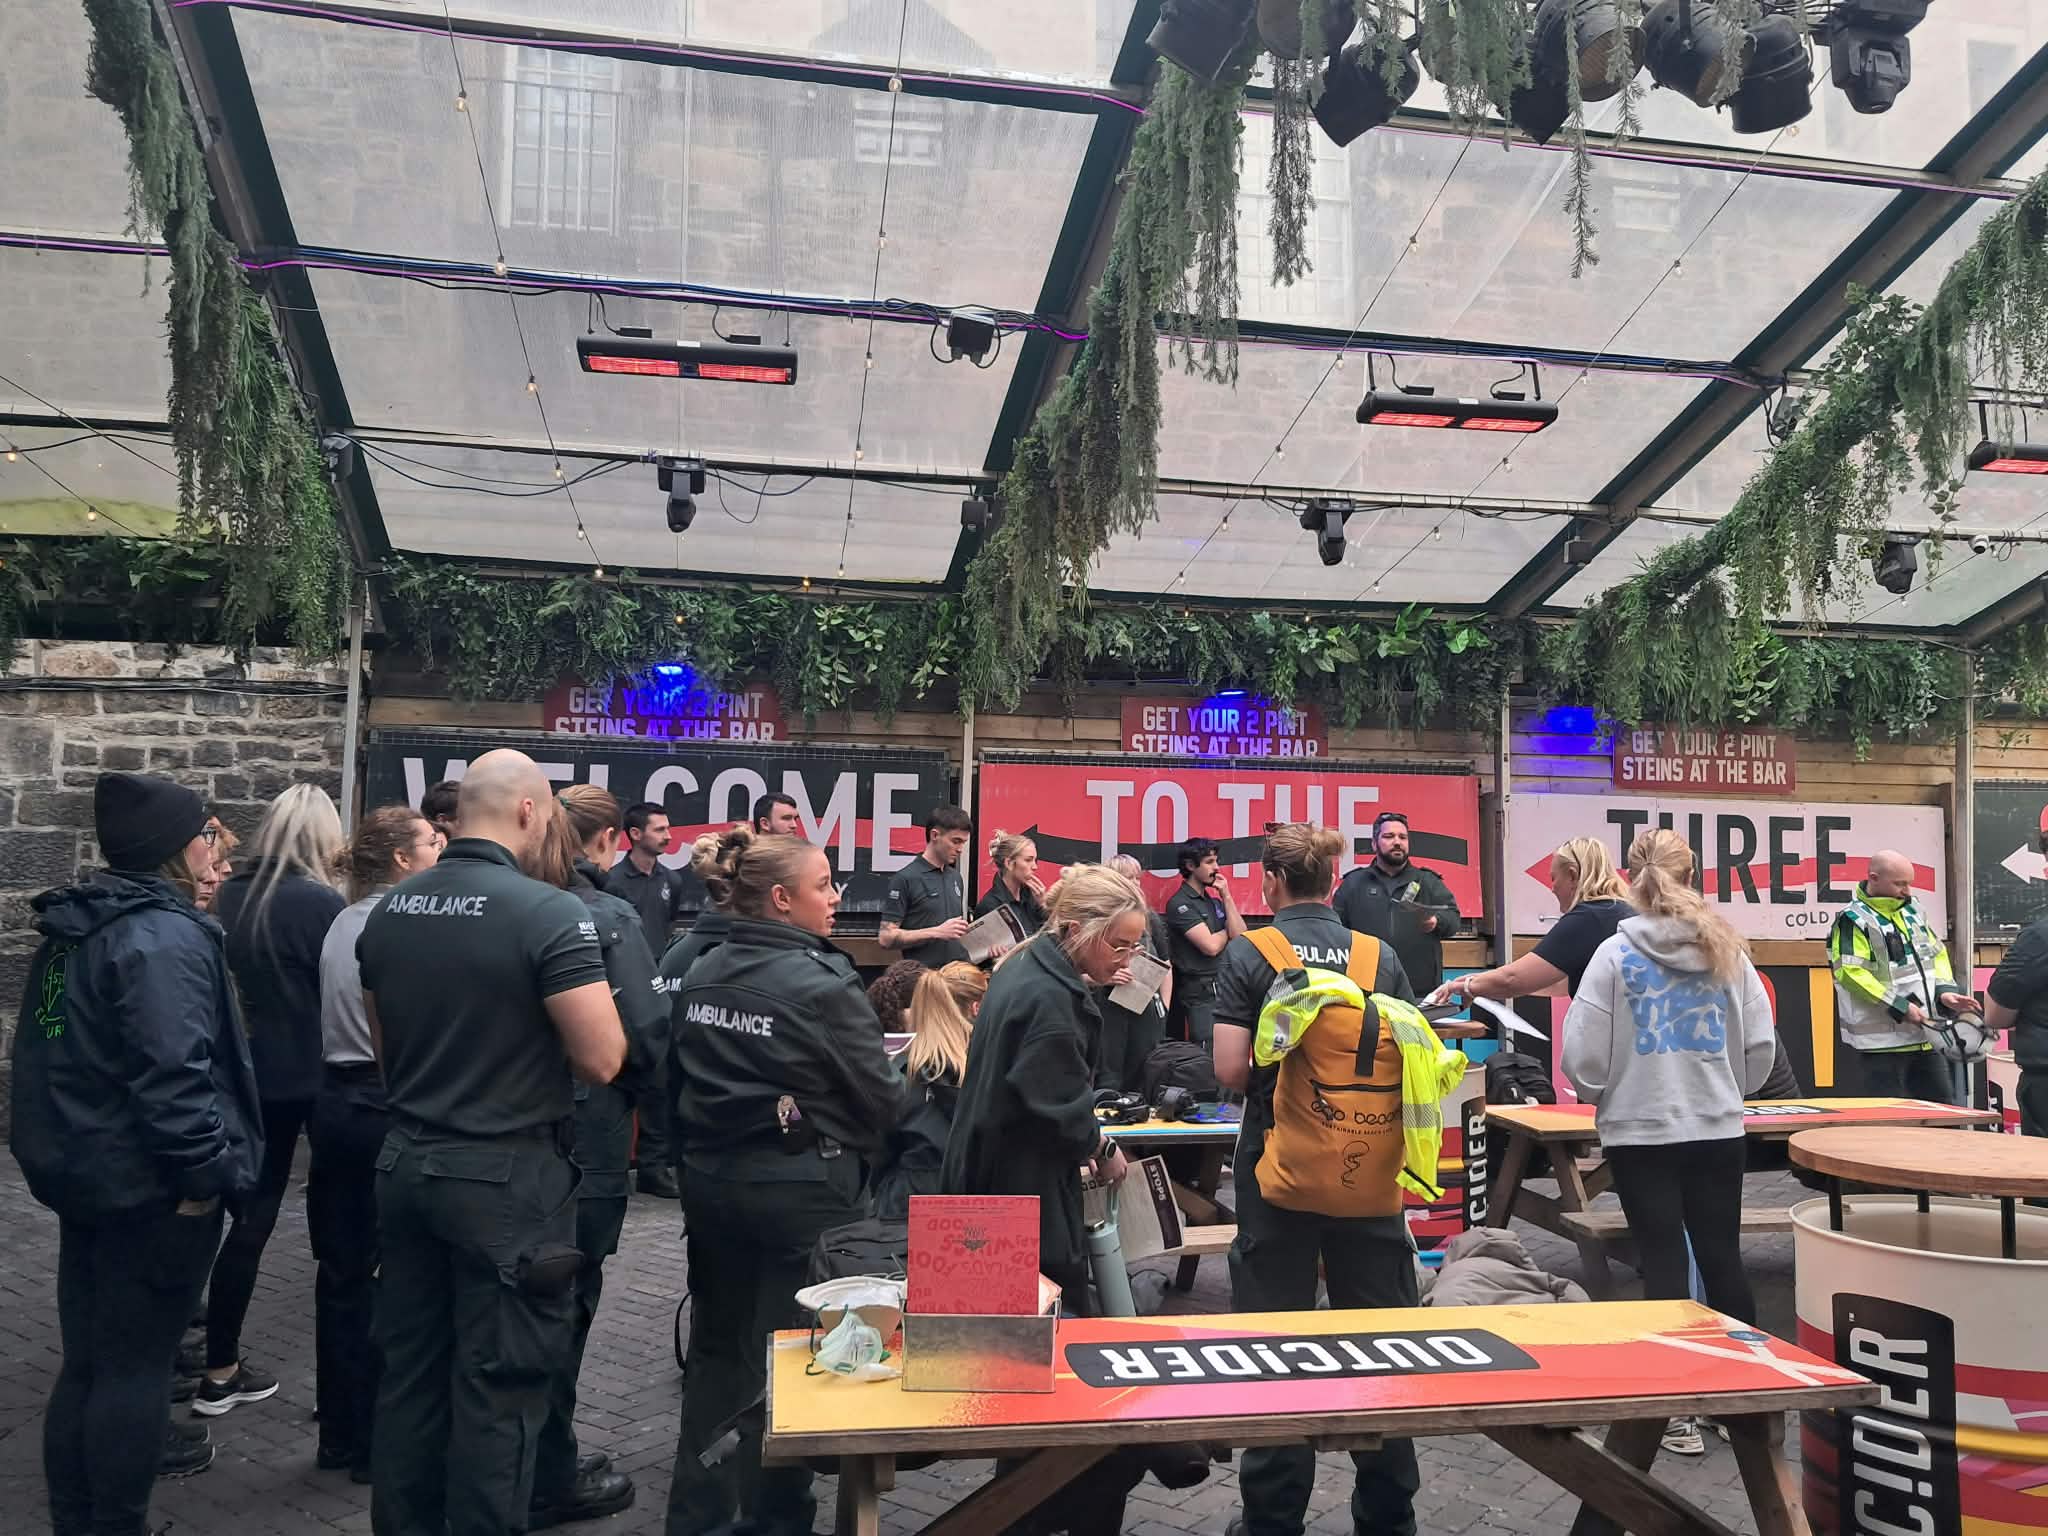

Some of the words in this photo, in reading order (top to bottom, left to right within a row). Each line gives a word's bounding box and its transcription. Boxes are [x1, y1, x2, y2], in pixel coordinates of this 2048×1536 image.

[713, 692, 764, 718] PINT
[1142, 706, 1180, 732] GET
[1187, 708, 1240, 734] YOUR
[1246, 711, 1259, 735] 2
[1724, 734, 1737, 757] 2
[1740, 734, 1777, 758] PINT
[1622, 756, 1684, 781] STEINS
[1689, 758, 1710, 783] AT
[1716, 759, 1748, 784] THE
[1752, 760, 1787, 785] BAR
[1086, 780, 1189, 879] TO
[385, 894, 489, 916] AMBULANCE
[1785, 911, 1830, 928] COLD
[1293, 945, 1350, 965] BULAN
[685, 1002, 774, 1037] AMBULANCE
